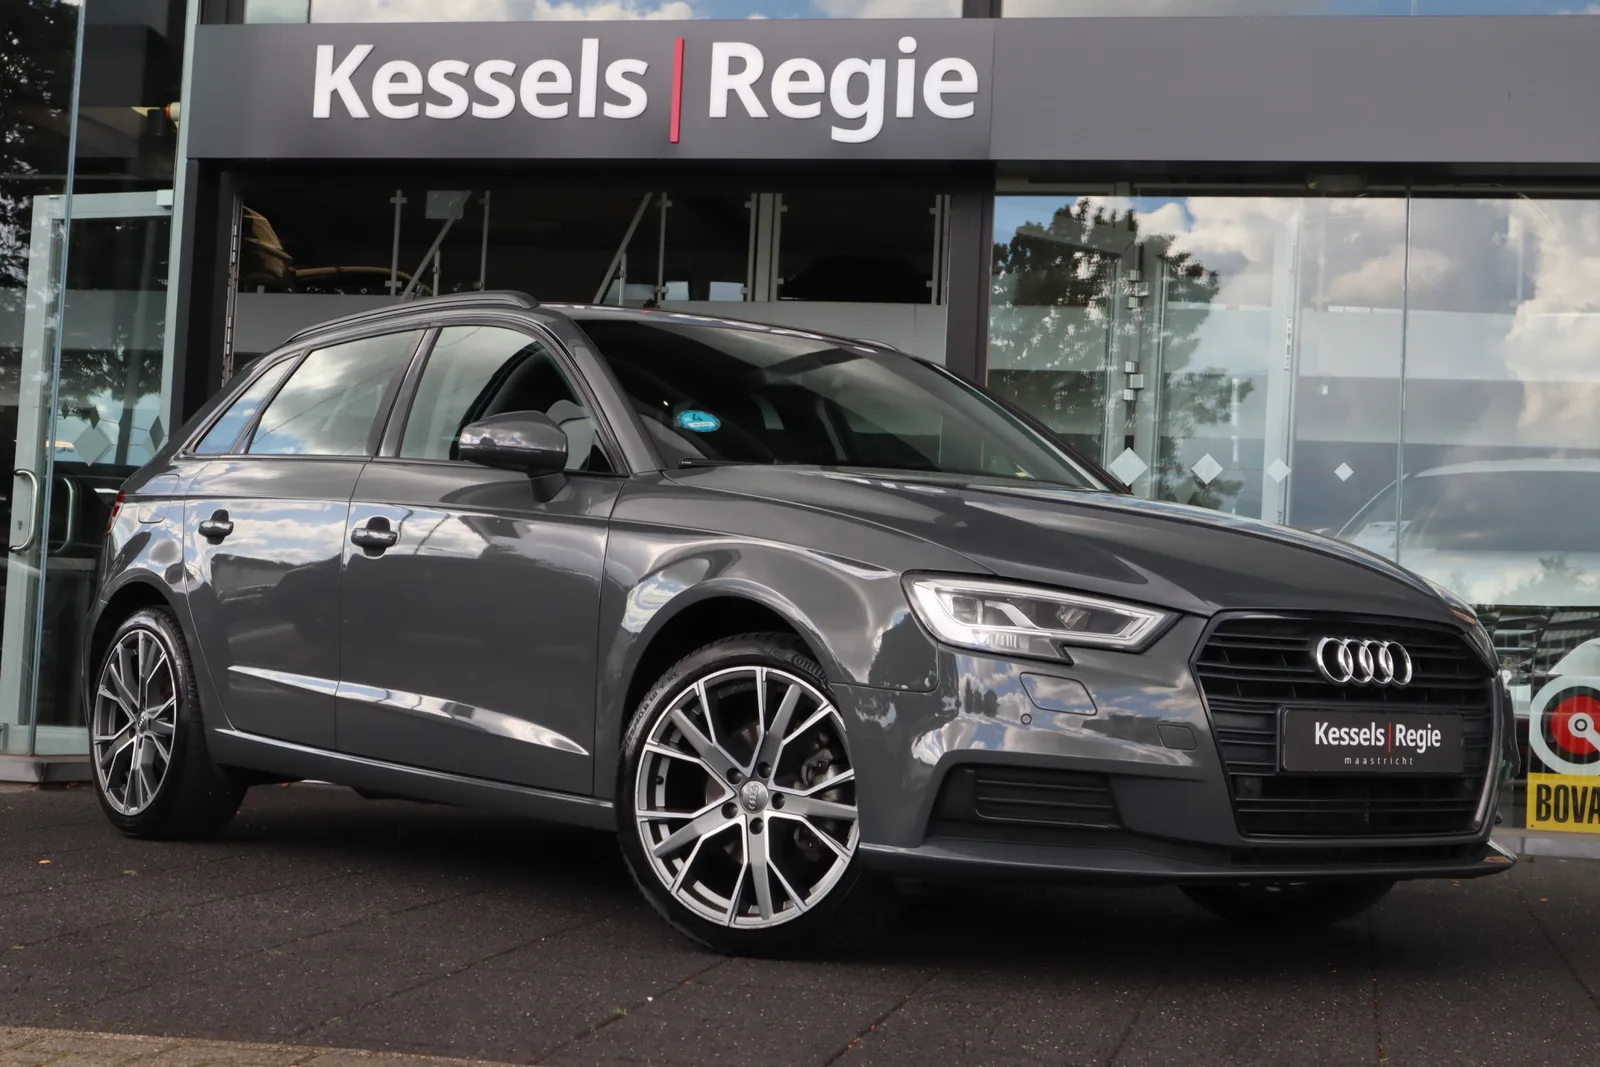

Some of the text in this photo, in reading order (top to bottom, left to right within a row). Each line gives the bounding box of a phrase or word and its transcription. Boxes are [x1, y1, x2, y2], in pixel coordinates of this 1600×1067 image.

[312, 36, 979, 143] Kessels Regie
[1314, 721, 1442, 754] Kessels Regie
[1344, 756, 1413, 766] maastricht
[1535, 783, 1600, 824] BOVA
